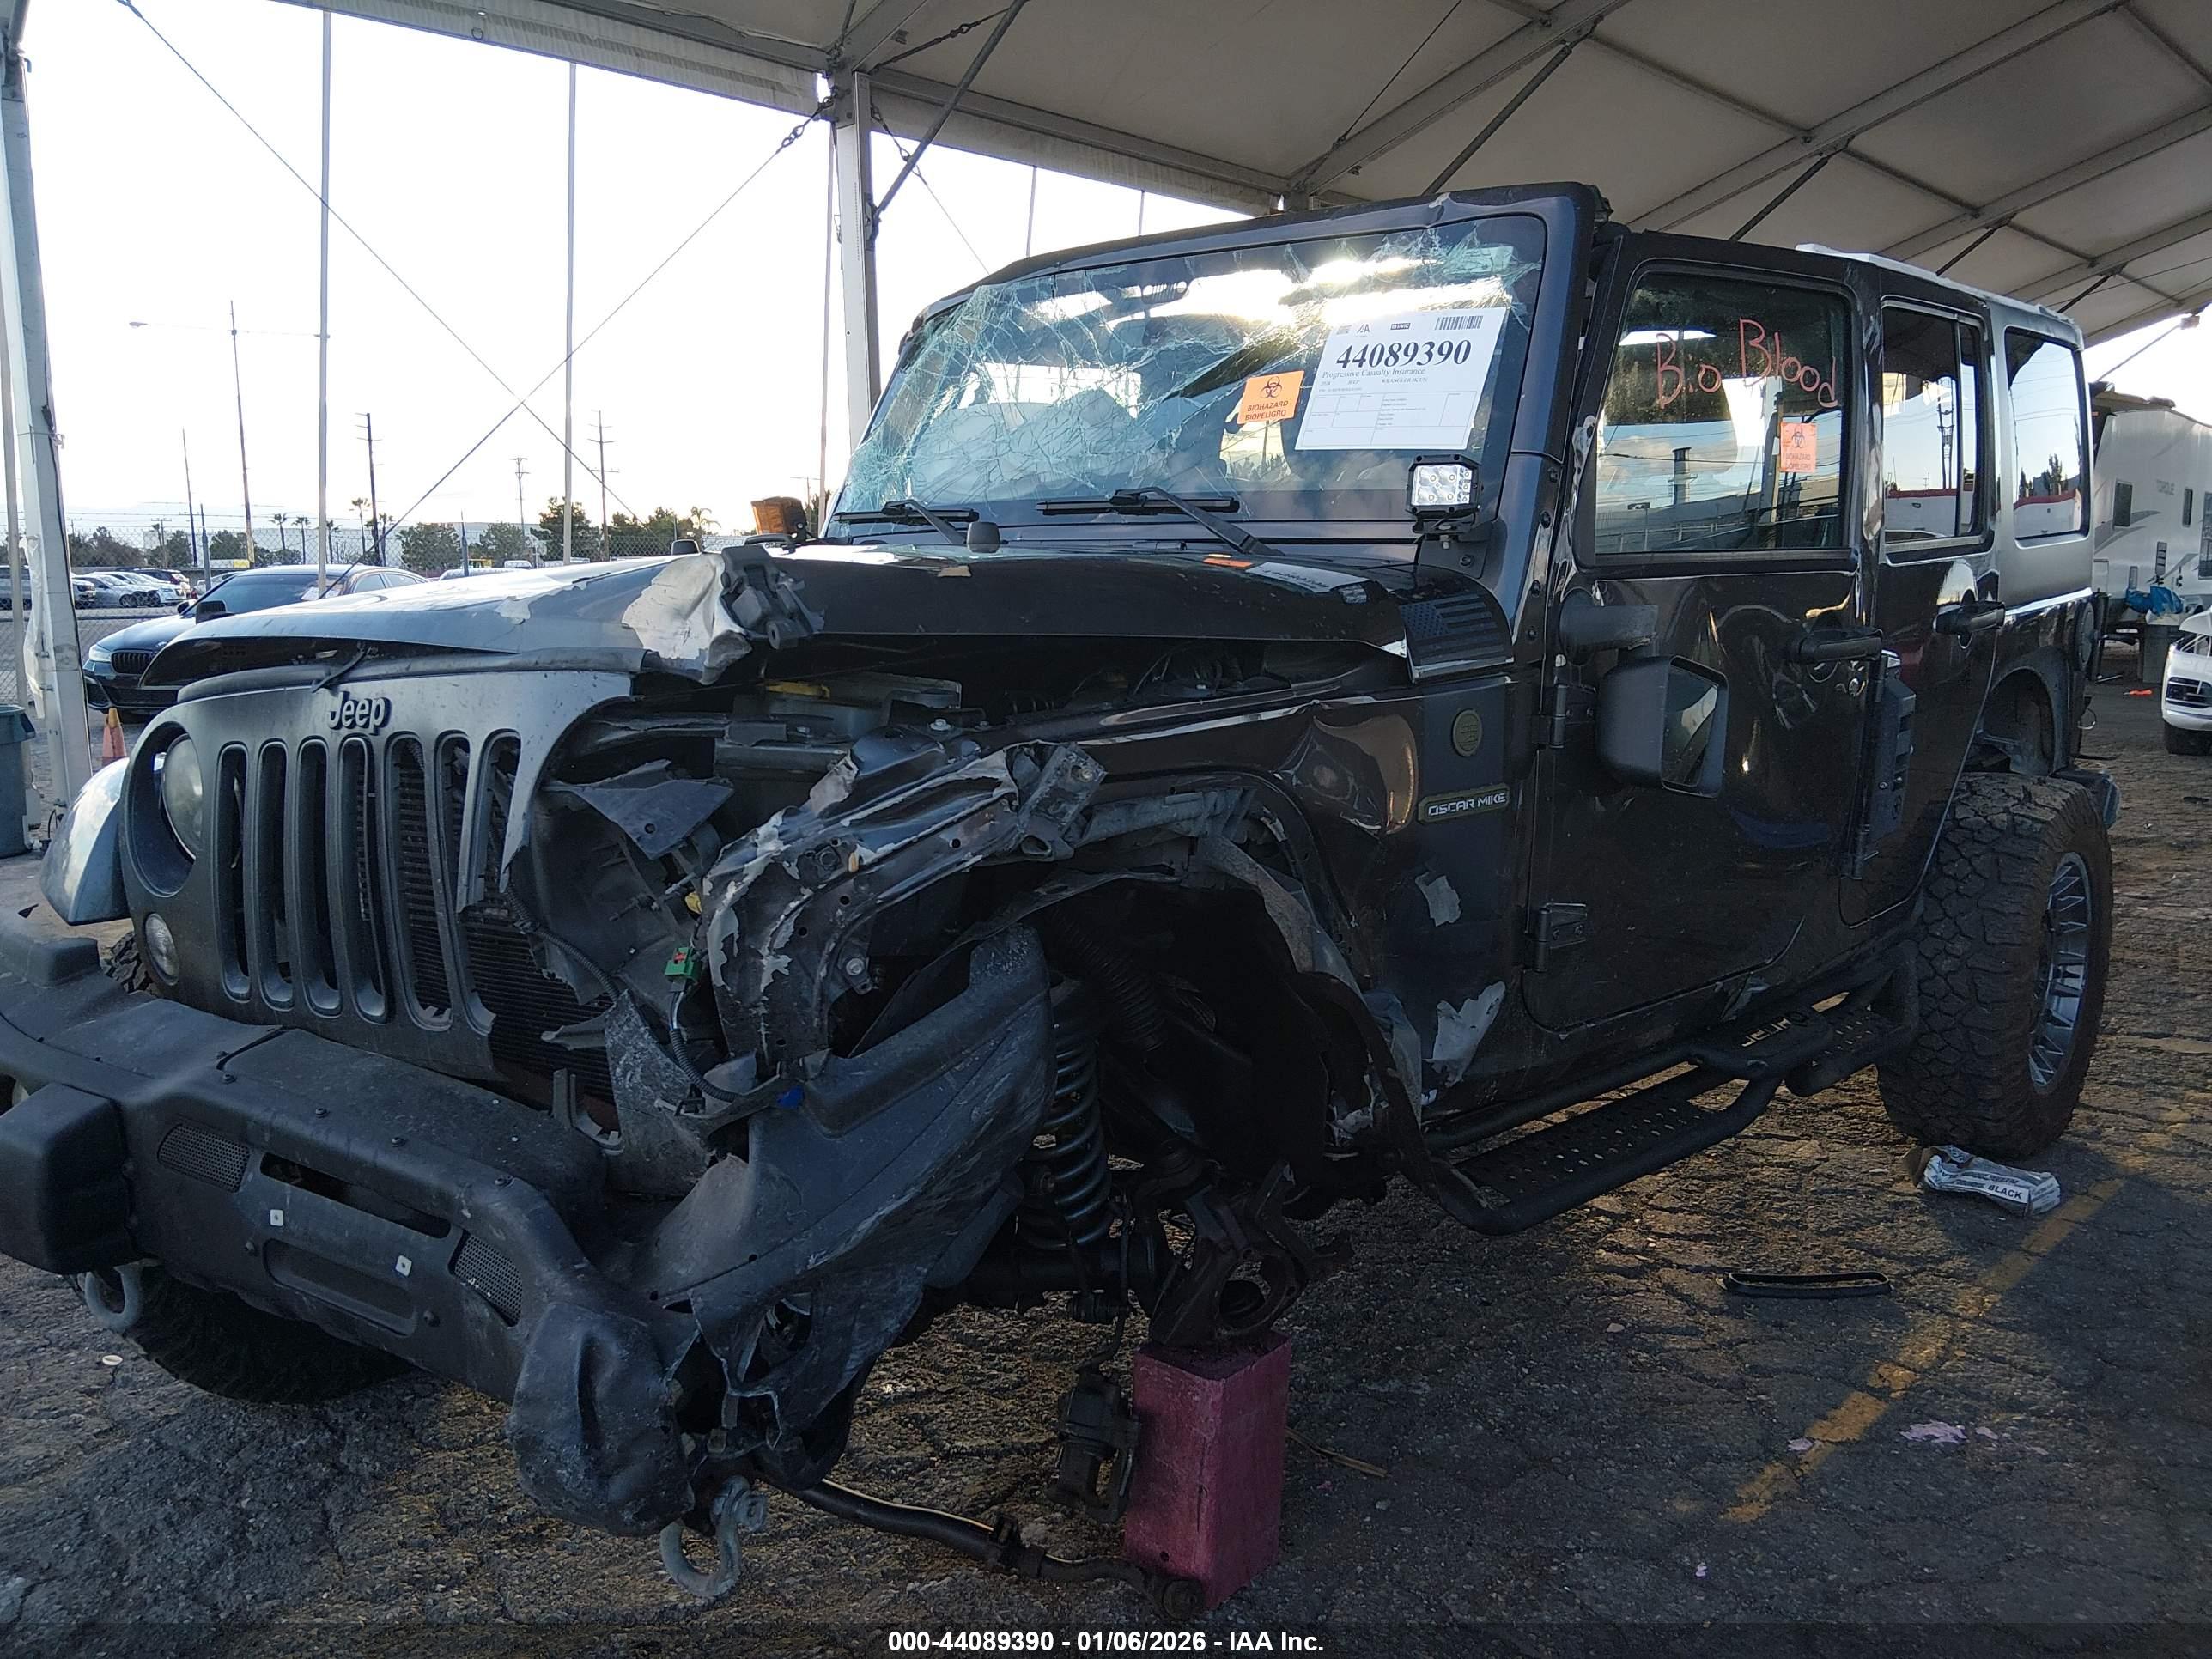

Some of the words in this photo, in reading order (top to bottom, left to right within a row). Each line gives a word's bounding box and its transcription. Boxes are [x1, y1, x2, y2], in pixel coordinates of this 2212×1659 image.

[1336, 339, 1472, 368] 44089390
[1739, 316, 1838, 408] Blood
[1322, 370, 1360, 380] Progressive
[1361, 368, 1389, 378] Casualty
[1392, 368, 1425, 376] Insurance
[1245, 410, 1286, 421] BIOPELIGRO
[1247, 400, 1289, 412] BIOHAZARD
[328, 690, 392, 736] Jeep
[1428, 799, 1475, 816] OSCAR
[1477, 793, 1506, 807] MIKE
[1987, 1183, 2022, 1200] BLACK
